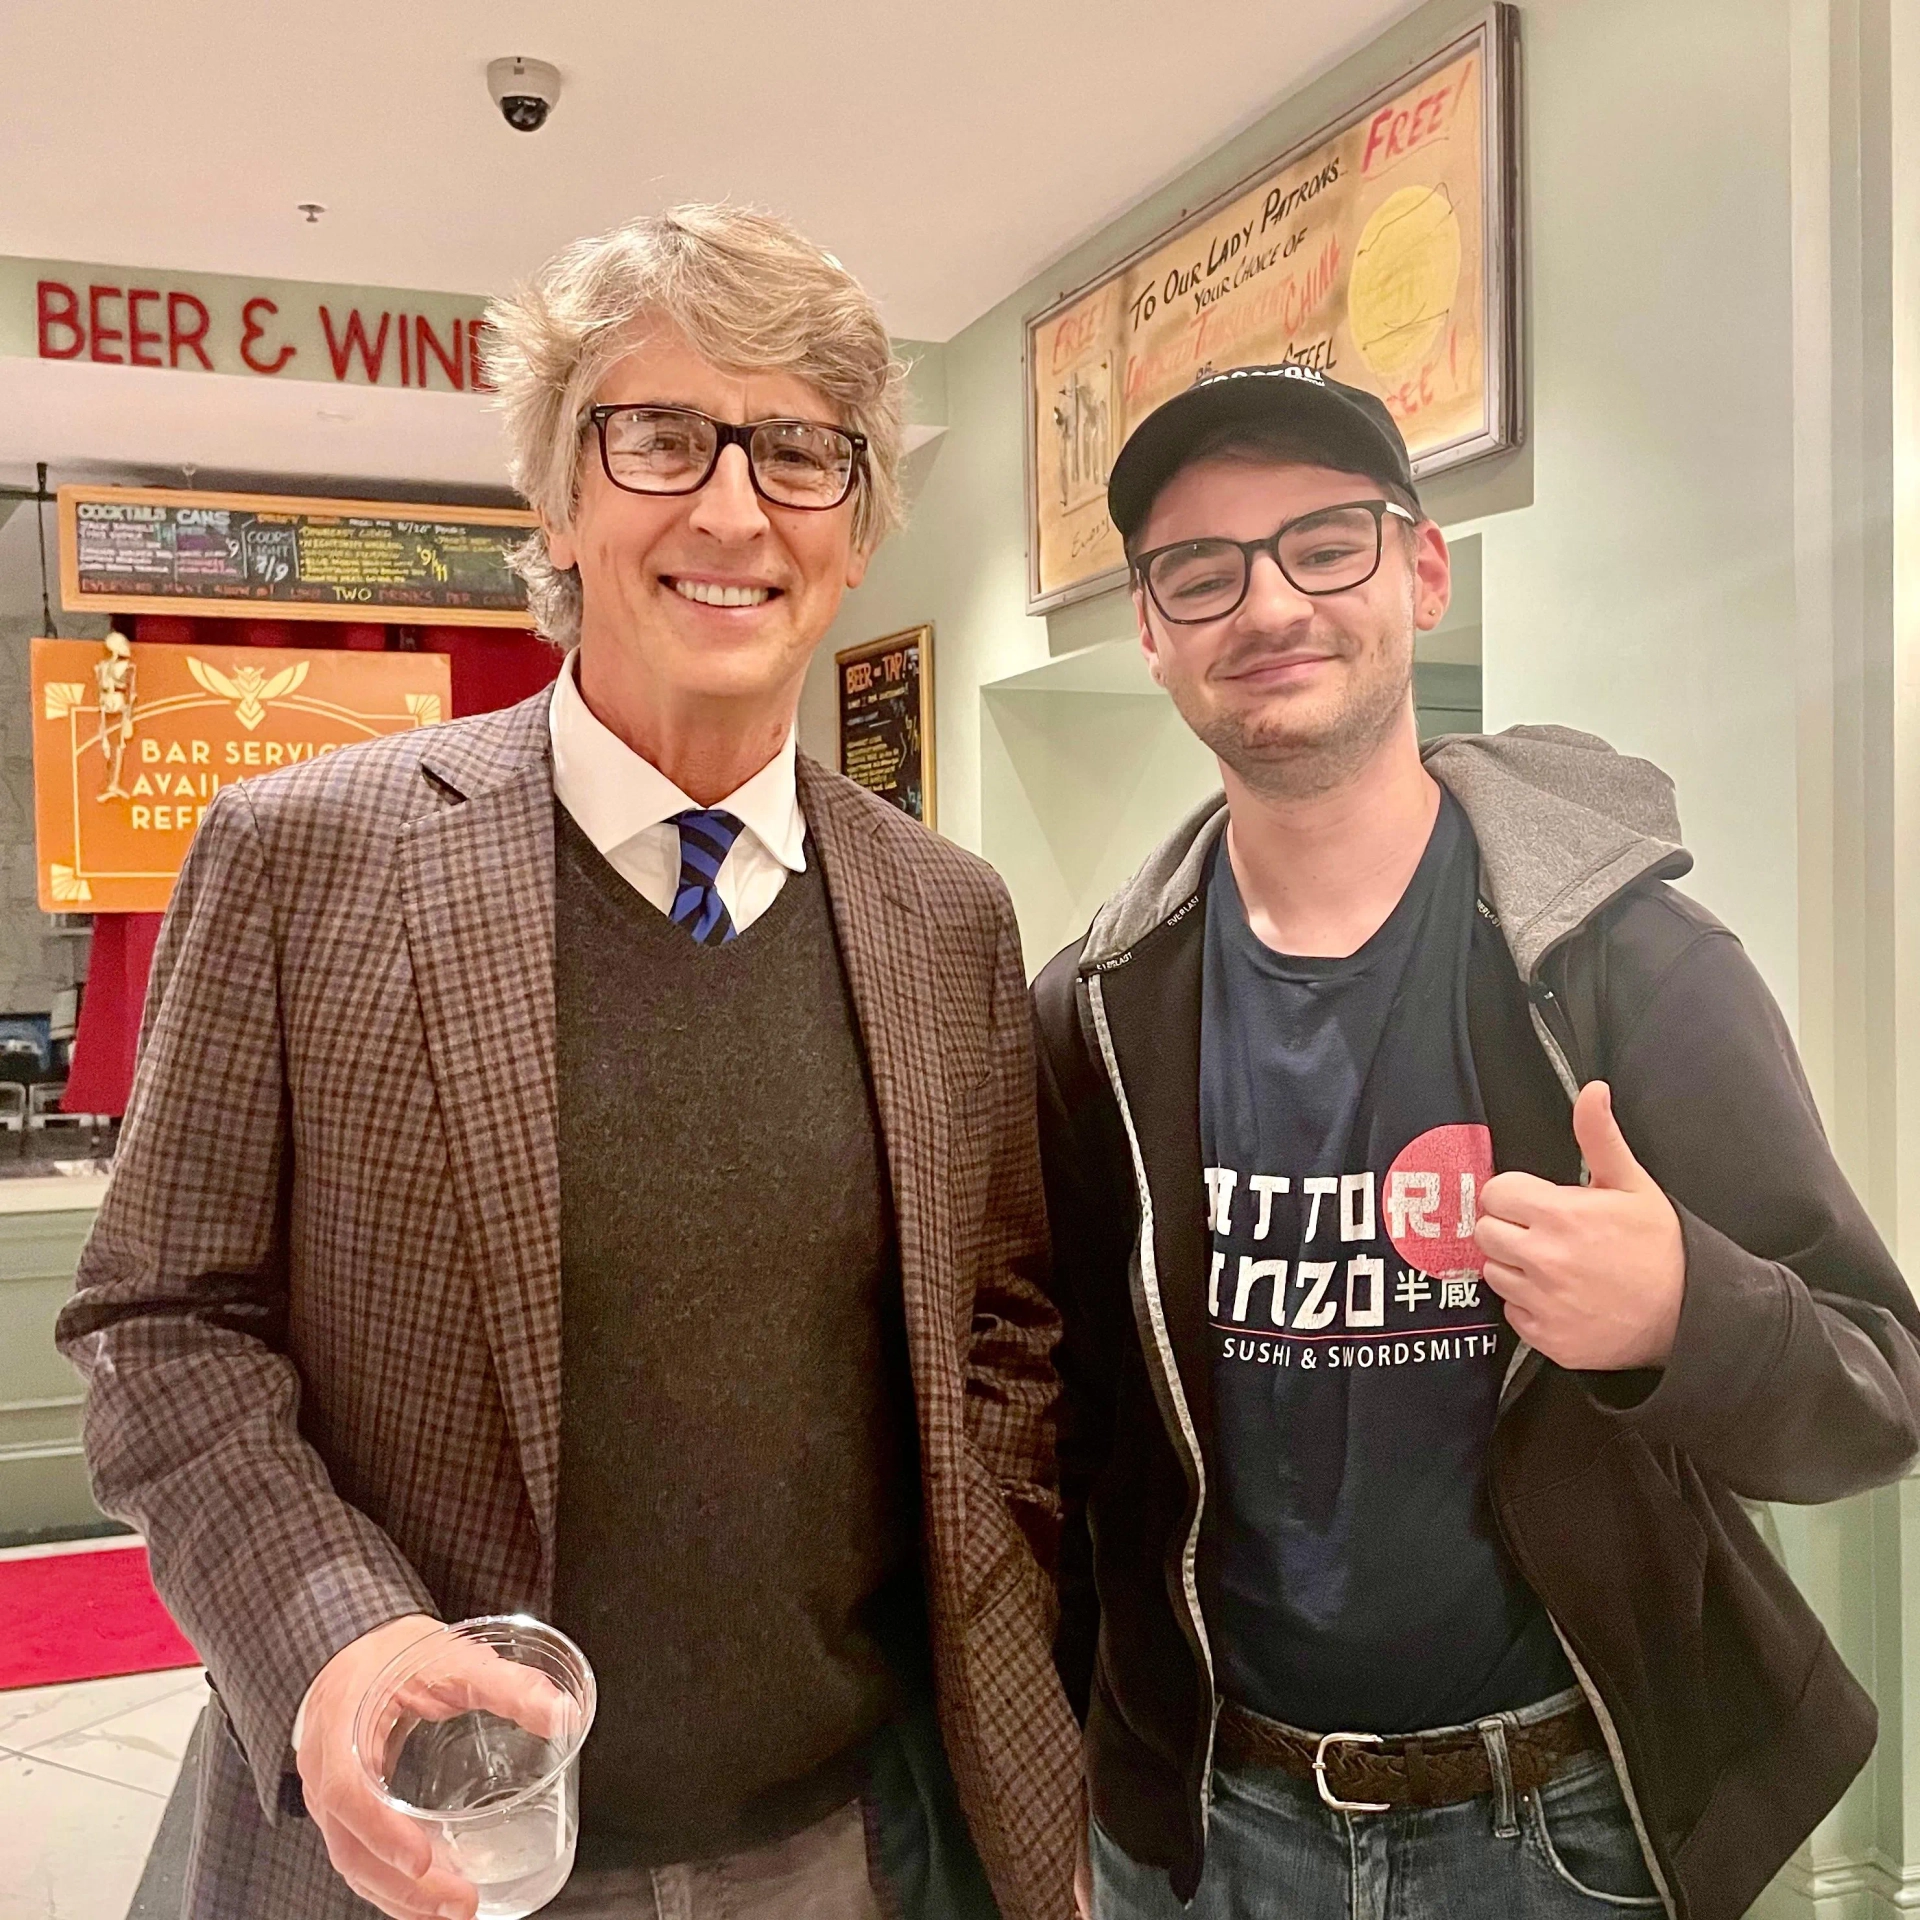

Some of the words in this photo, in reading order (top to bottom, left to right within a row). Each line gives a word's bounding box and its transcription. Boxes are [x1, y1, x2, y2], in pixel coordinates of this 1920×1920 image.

[1360, 60, 1474, 174] FREE!
[1129, 280, 1156, 332] TO
[1163, 262, 1203, 304] OUR
[1206, 219, 1254, 277] LADY
[1193, 275, 1231, 315] YOUR
[1283, 227, 1308, 258] OF
[36, 280, 215, 371] BEER
[241, 298, 296, 374] &
[176, 509, 231, 526] CANS
[332, 585, 372, 602] TWO
[141, 739, 211, 764] BAR
[1222, 1337, 1290, 1368] SUSHI
[1300, 1347, 1317, 1369] &
[1327, 1334, 1498, 1368] SWORDSMITH
